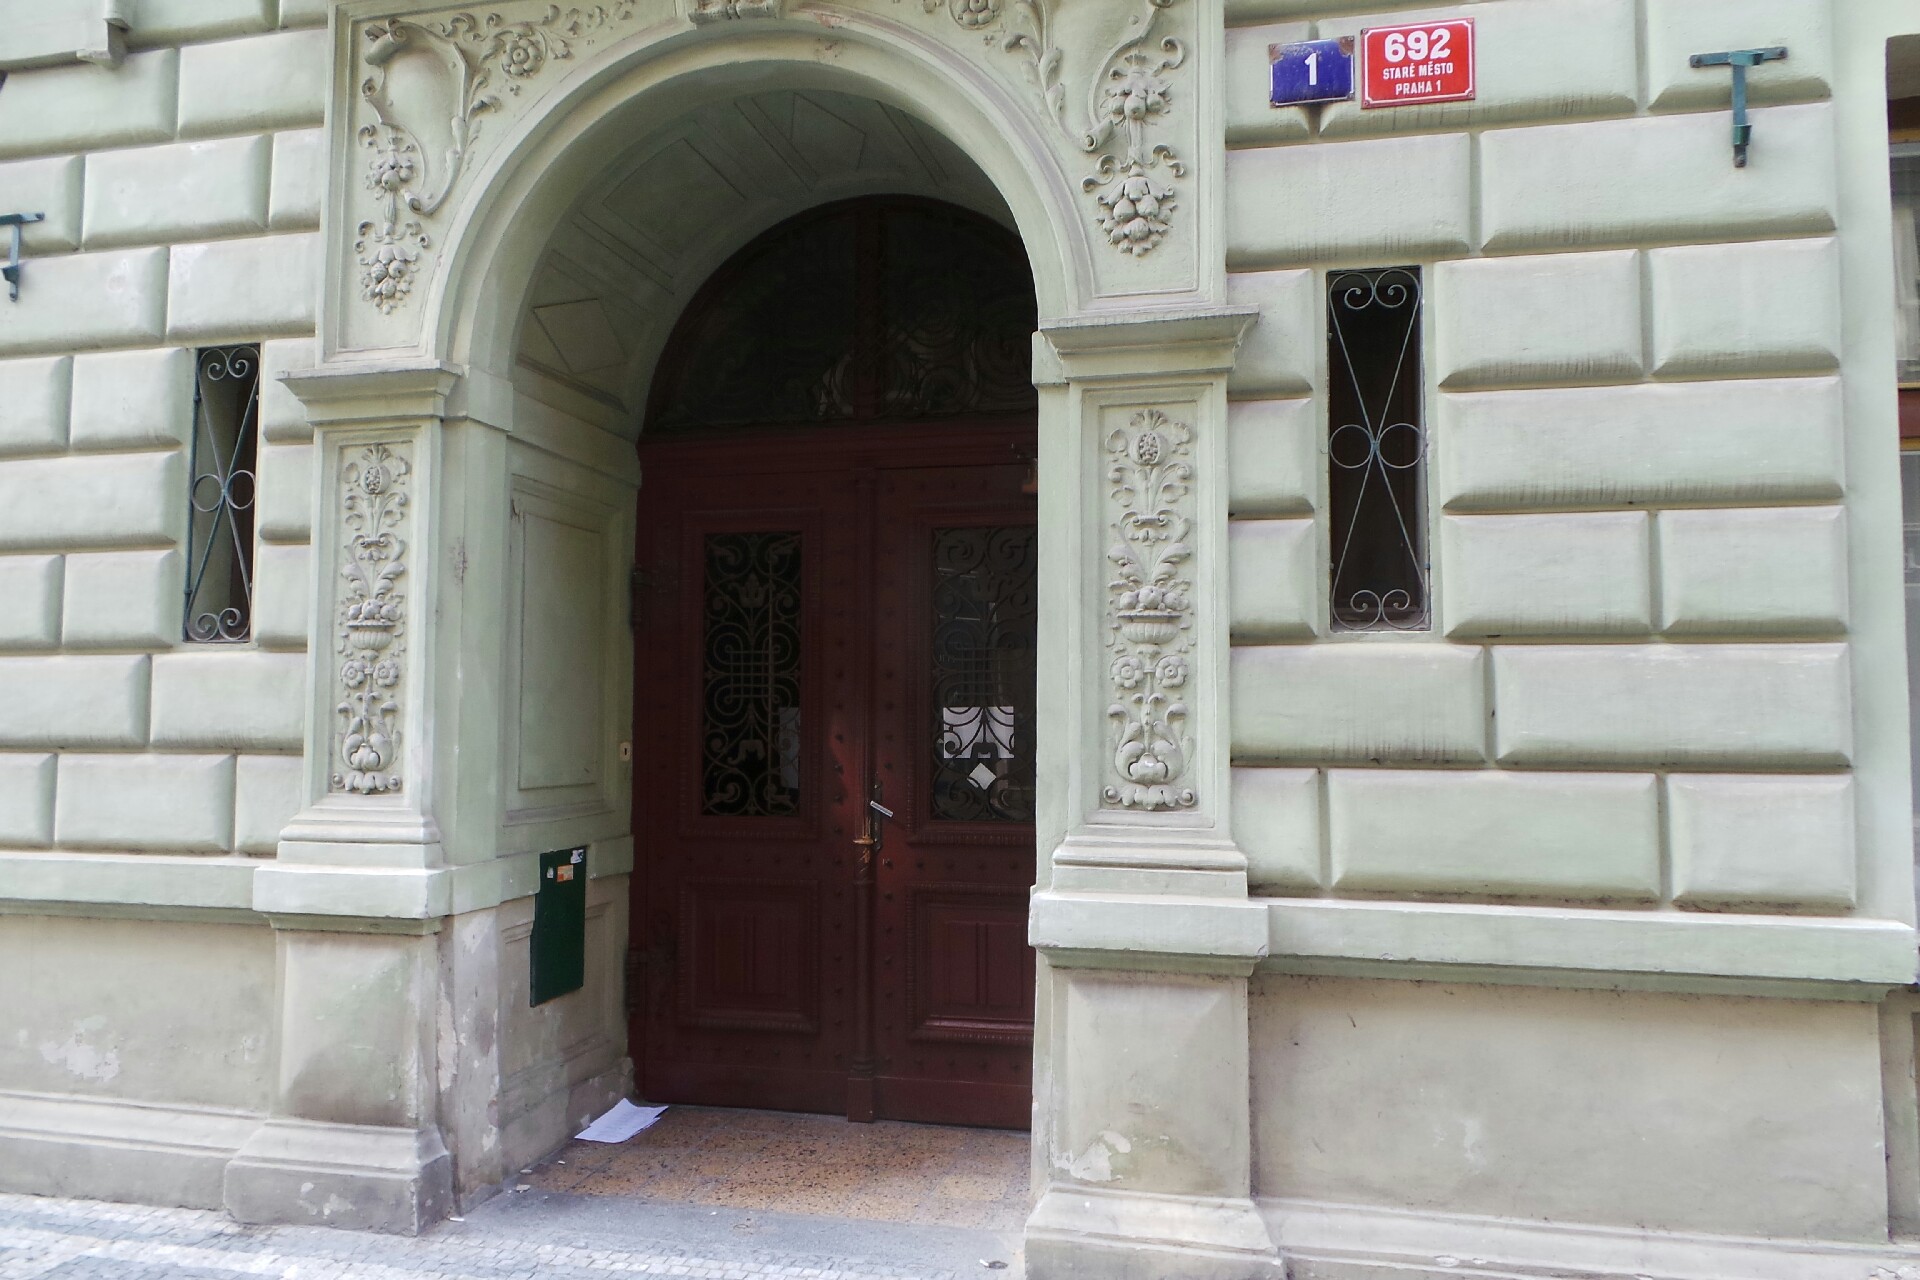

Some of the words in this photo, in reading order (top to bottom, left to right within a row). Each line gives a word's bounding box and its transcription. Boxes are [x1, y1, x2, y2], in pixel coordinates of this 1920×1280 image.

[1384, 28, 1451, 62] 692
[1305, 52, 1318, 86] 1
[1383, 63, 1416, 80] STARÉ
[1395, 81, 1432, 95] PRAHA
[1436, 80, 1441, 92] 1
